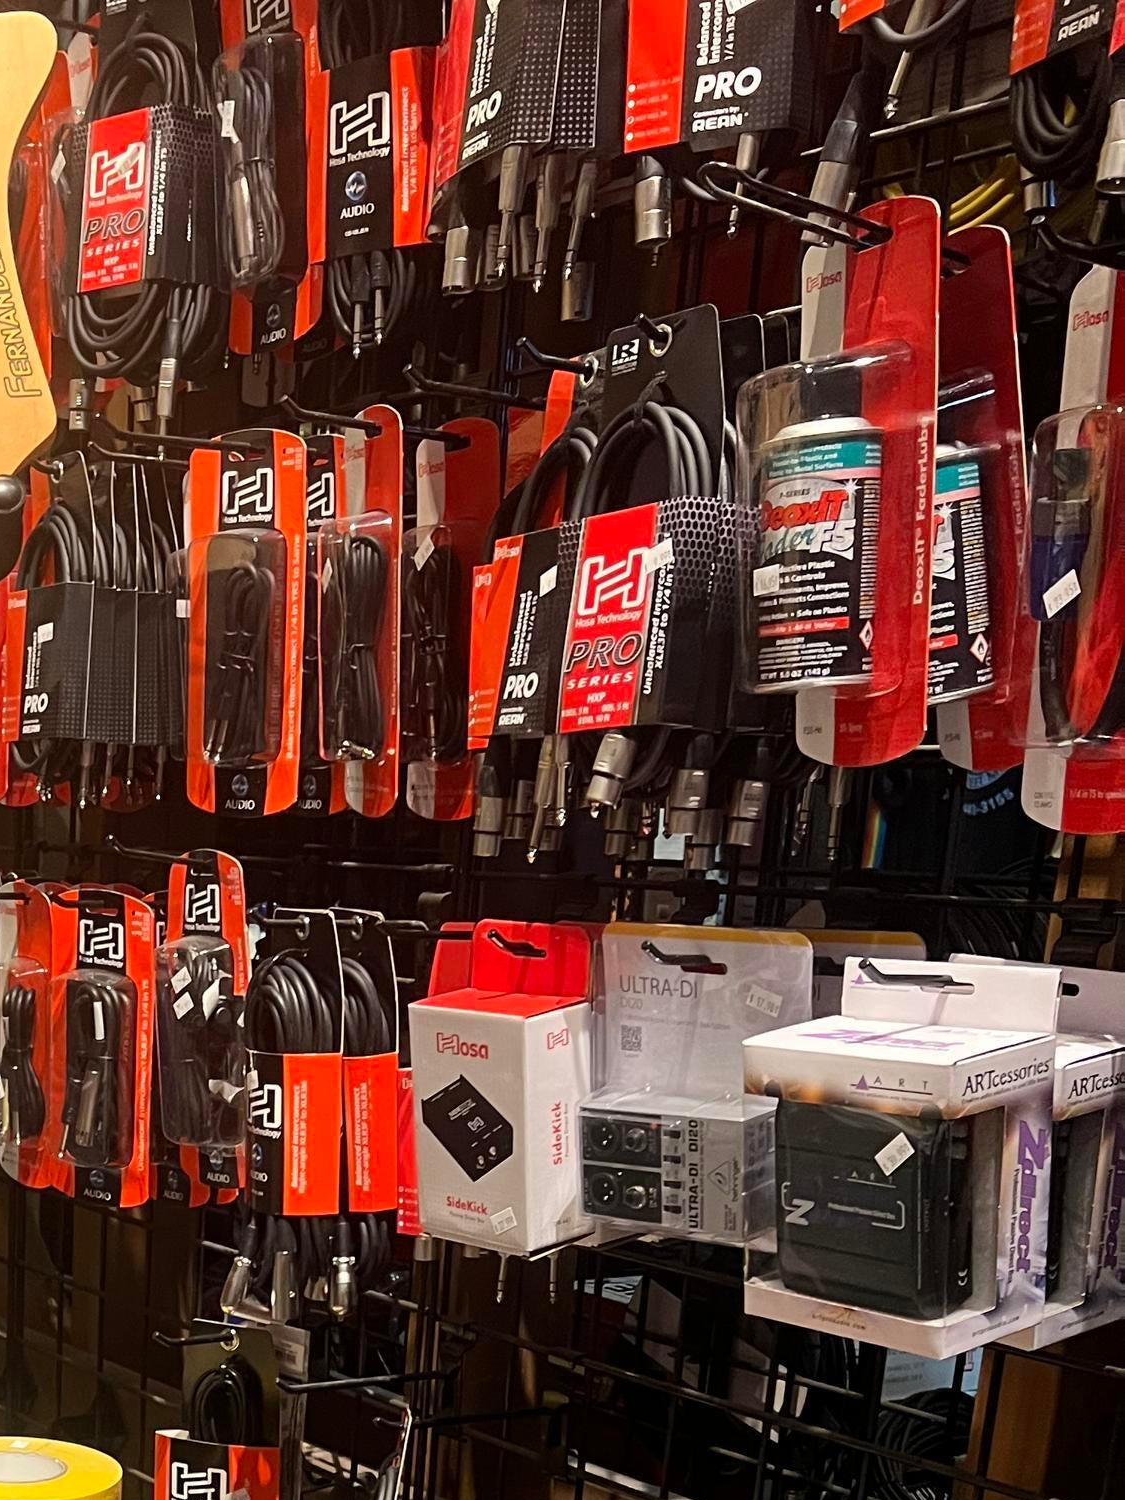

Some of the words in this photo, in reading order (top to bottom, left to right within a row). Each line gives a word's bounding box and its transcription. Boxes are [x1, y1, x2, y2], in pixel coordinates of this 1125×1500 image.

[696, 1, 711, 66] Balanced
[709, 0, 724, 64] Interconn
[726, 15, 736, 32] TRS
[724, 43, 735, 61] 1/4
[694, 66, 762, 103] PRO
[402, 86, 410, 154] Interconnect
[466, 90, 502, 133] PRO
[347, 146, 390, 164] Technology
[401, 157, 409, 212] Balanced
[340, 203, 375, 219] AUDIO
[83, 208, 146, 244] PRO
[86, 239, 140, 257] SERIES
[806, 272, 842, 293] Hosa
[1073, 310, 1110, 331] Hosa
[261, 327, 286, 344] AUDIO
[238, 513, 273, 524] Technology
[809, 518, 856, 553] F5
[293, 534, 301, 571] Same
[662, 589, 672, 612] 1/4
[807, 591, 850, 602] Connections
[575, 616, 594, 629] Hosa
[597, 610, 642, 626] Technology
[563, 631, 645, 673] PRO
[643, 618, 660, 694] Unbalanced
[288, 638, 297, 700] Interconnect
[567, 671, 634, 690] SERIES
[503, 672, 539, 700] PRO
[24, 693, 48, 714] PRO
[286, 702, 295, 759] Balanced
[225, 799, 255, 811] AUDIO
[94, 957, 124, 968] Technology
[619, 975, 698, 999] ULTRA-DI
[436, 1032, 489, 1060] Hosa
[962, 1059, 1051, 1098] ARTcessories
[551, 1100, 563, 1165] SideKick
[689, 1119, 699, 1152] DI20
[207, 1173, 230, 1184] AUDIO
[84, 1188, 111, 1201] AUDIO
[446, 1195, 488, 1216] SideKick
[689, 1162, 699, 1228] ULTRA-DI
